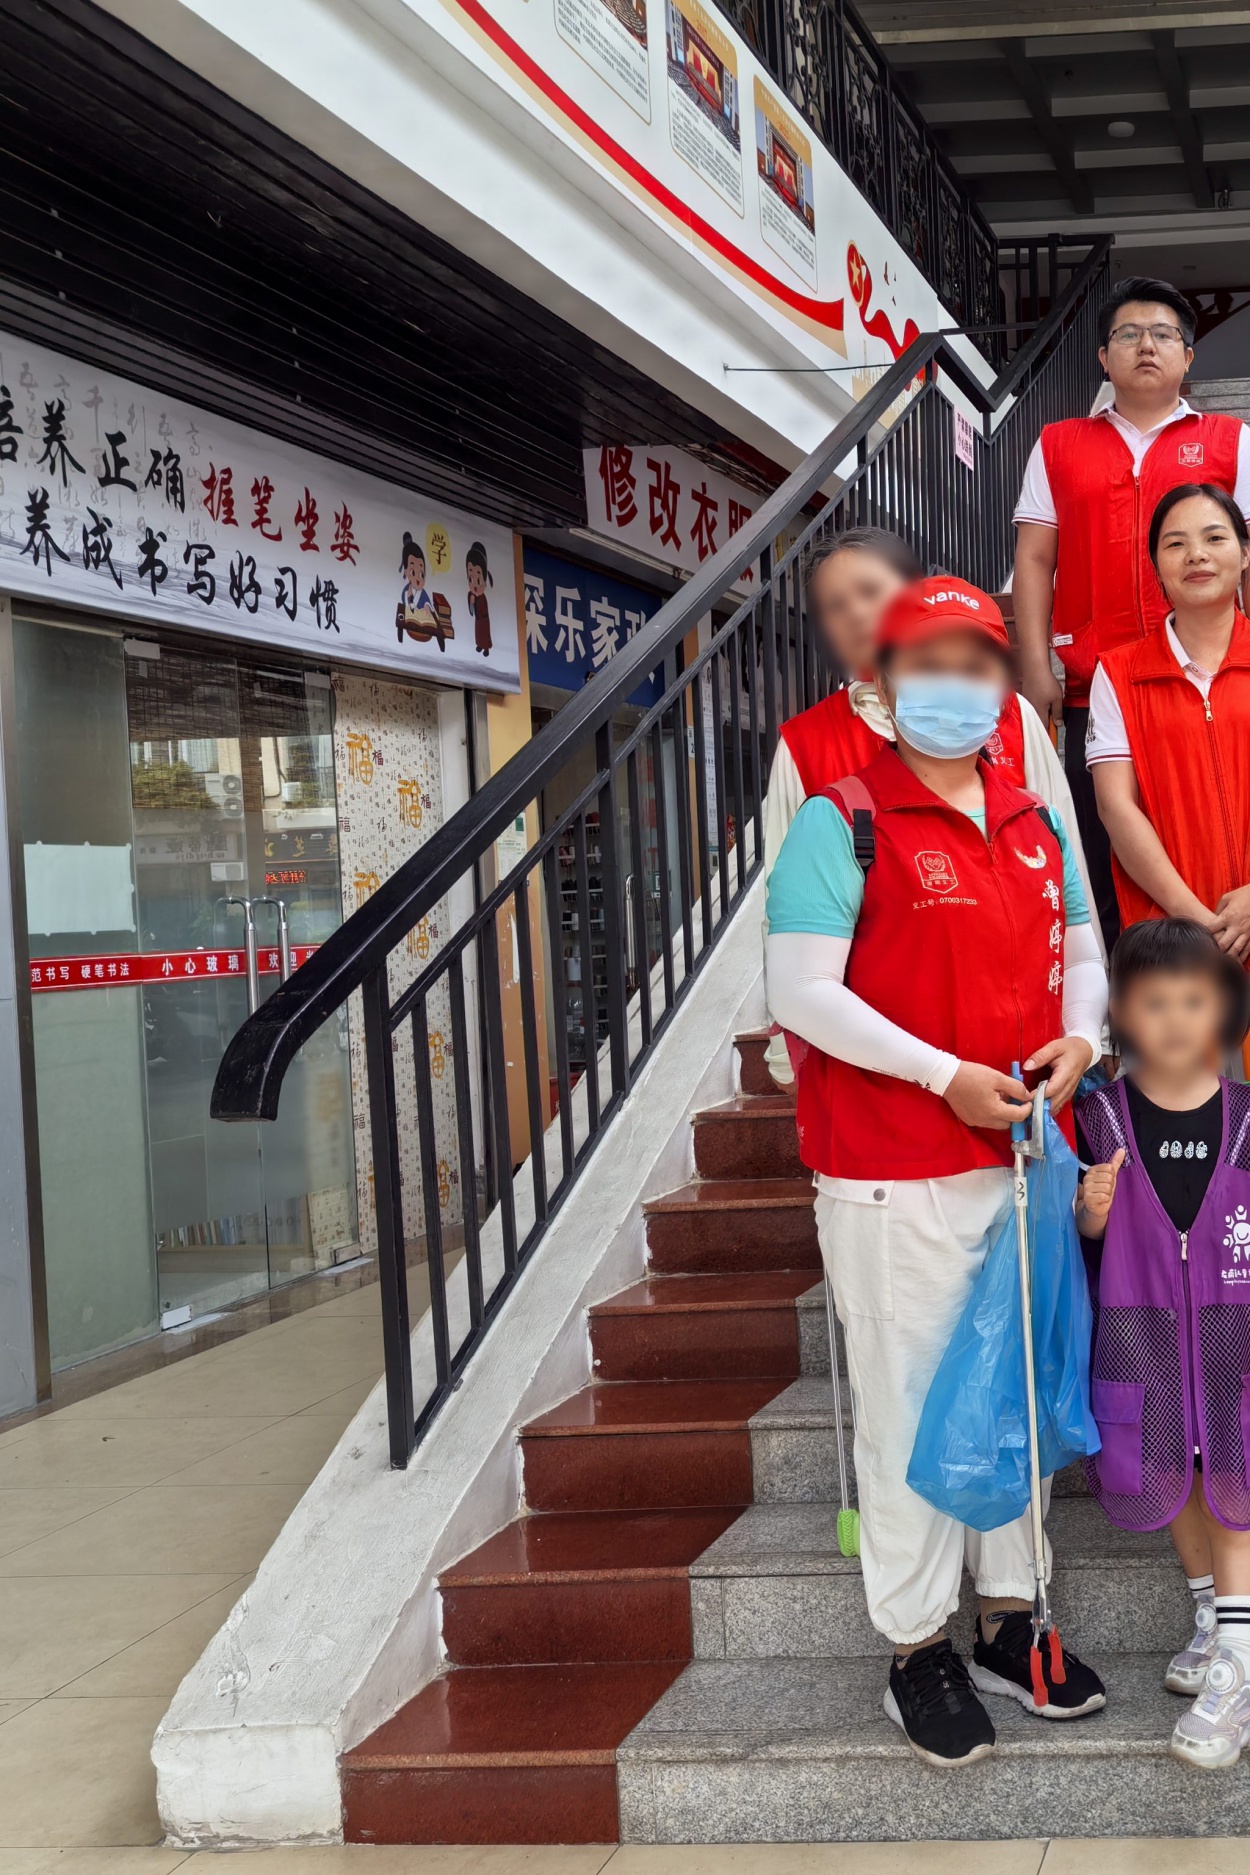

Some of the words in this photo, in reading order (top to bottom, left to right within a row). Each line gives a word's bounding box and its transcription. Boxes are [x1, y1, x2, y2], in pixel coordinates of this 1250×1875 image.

[431, 532, 447, 565] 学
[20, 486, 340, 634] 养成书写好习惯
[924, 591, 980, 610] vanke
[81, 963, 130, 979] 硬笔书法
[161, 955, 239, 976] 小心玻璃
